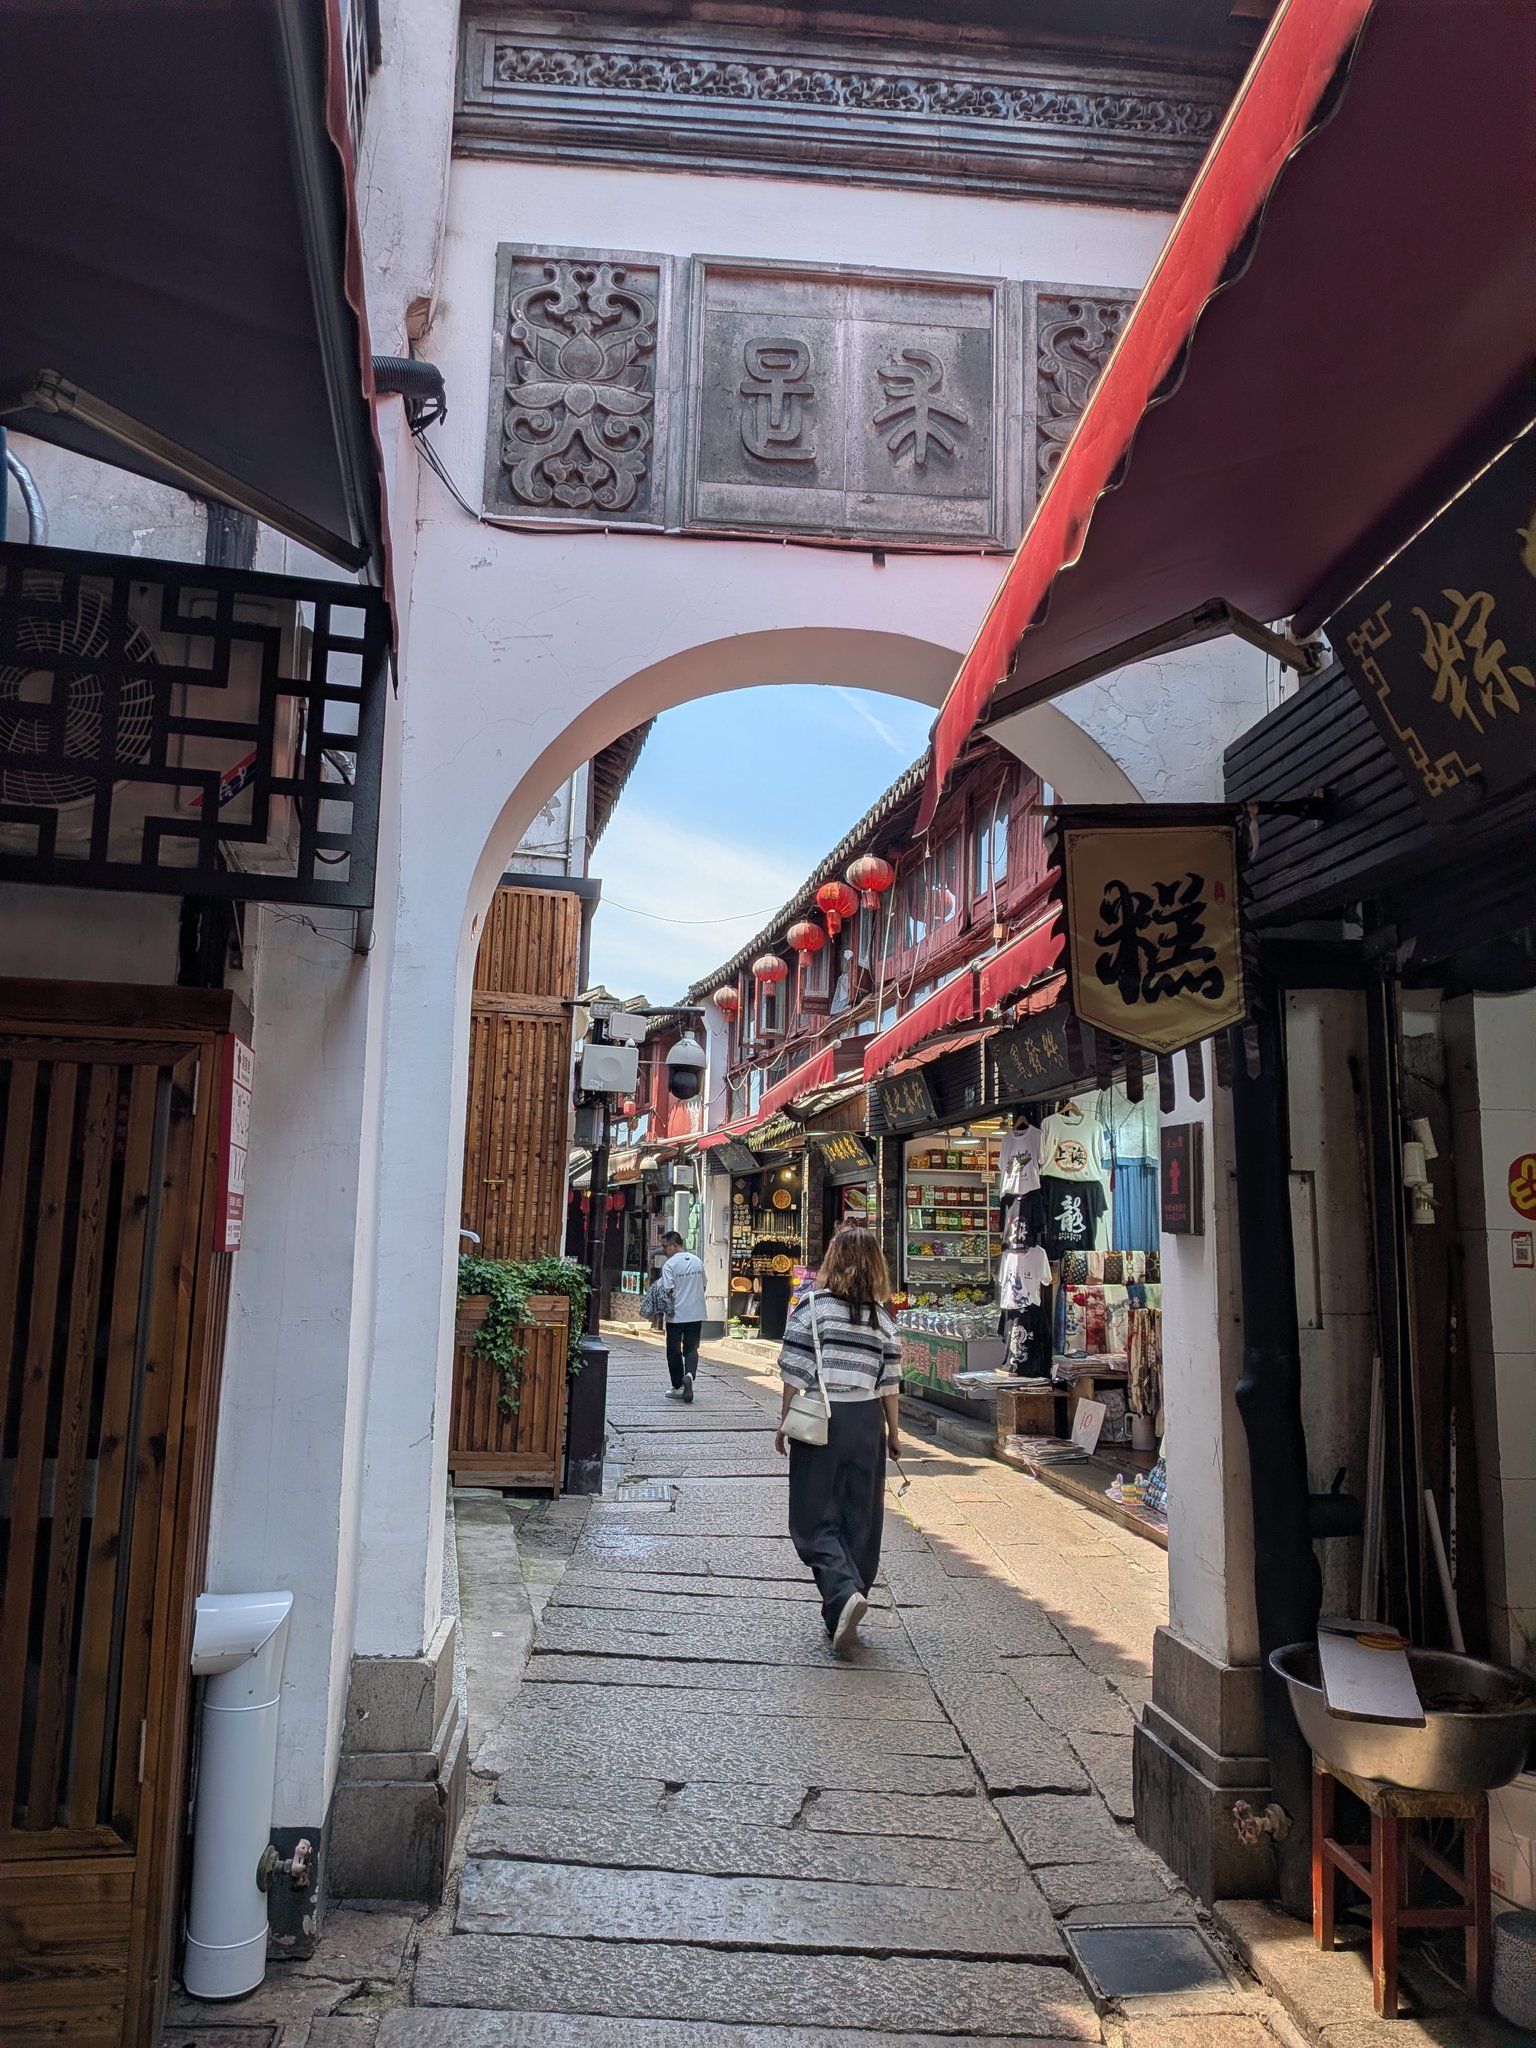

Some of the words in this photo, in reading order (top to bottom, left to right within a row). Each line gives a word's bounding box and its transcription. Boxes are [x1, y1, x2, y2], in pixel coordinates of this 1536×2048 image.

[1055, 1146, 1086, 1165] 上海
[1054, 1194, 1087, 1233] 龍
[1080, 1411, 1093, 1429] 10
